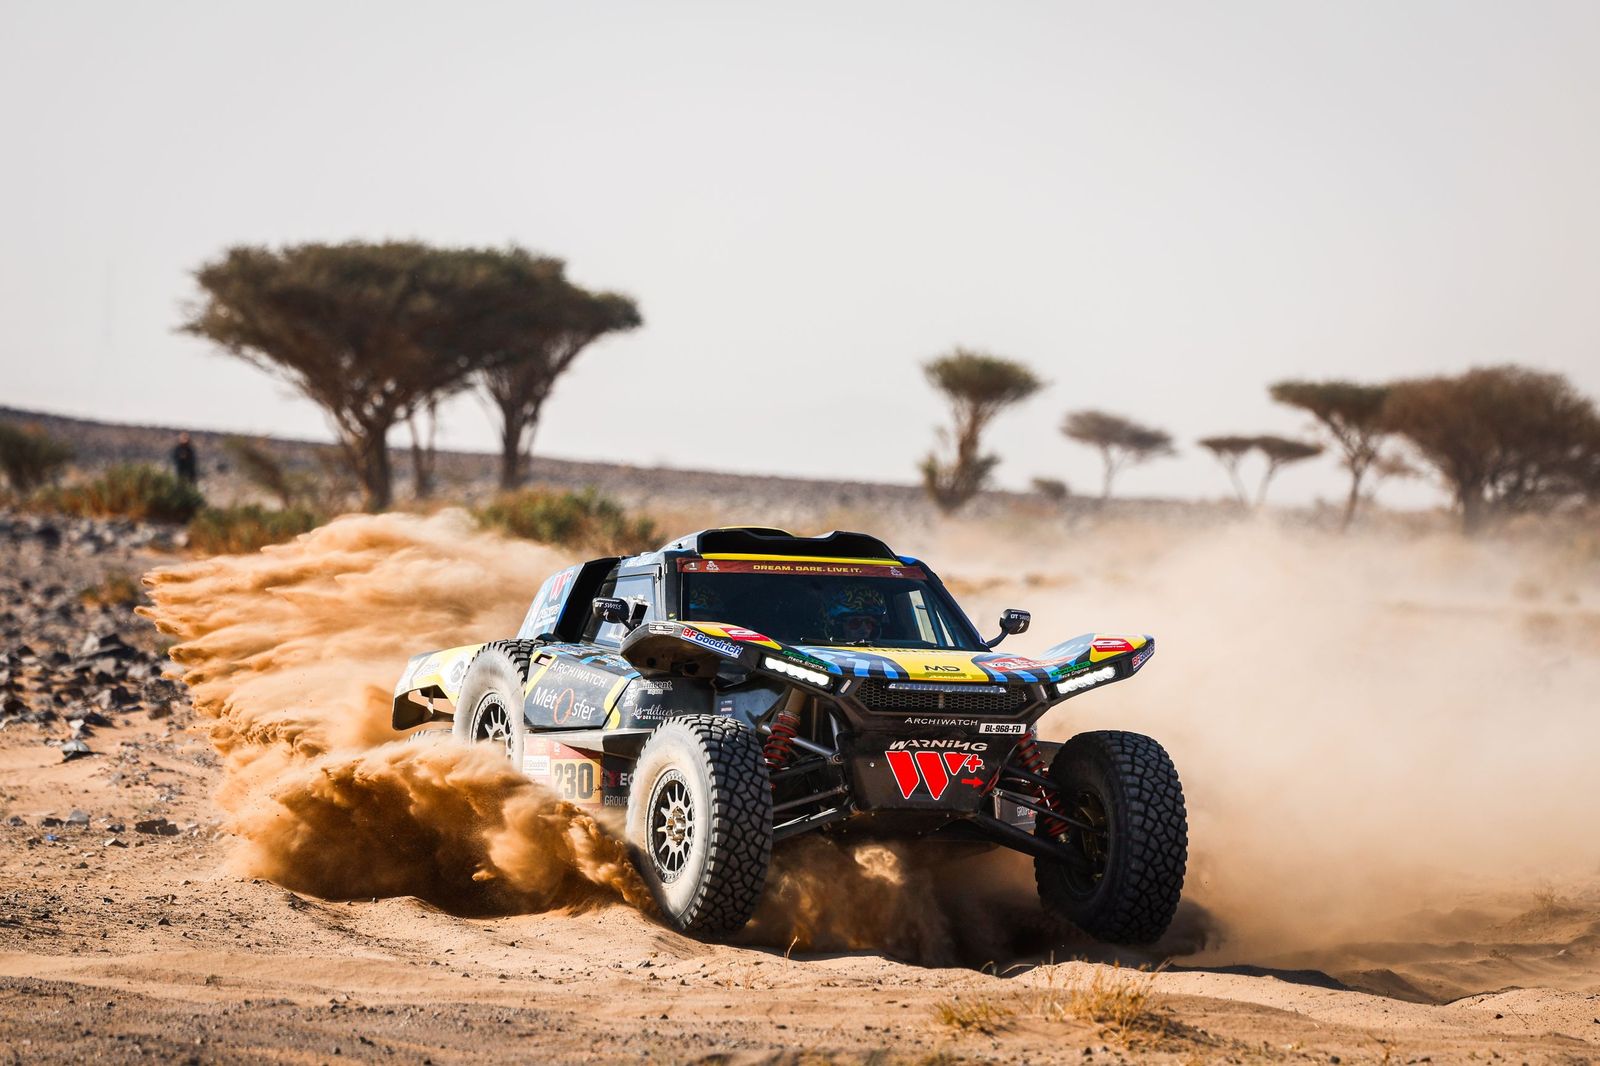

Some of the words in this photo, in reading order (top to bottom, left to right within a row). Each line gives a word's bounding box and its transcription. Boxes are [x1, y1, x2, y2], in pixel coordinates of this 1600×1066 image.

[683, 627, 742, 656] BFGoodrich
[550, 659, 608, 688] ARCHIWATCH
[904, 717, 978, 726] ARCHIWATCH
[984, 724, 1021, 733] BL-968-FD
[554, 762, 594, 800] 230
